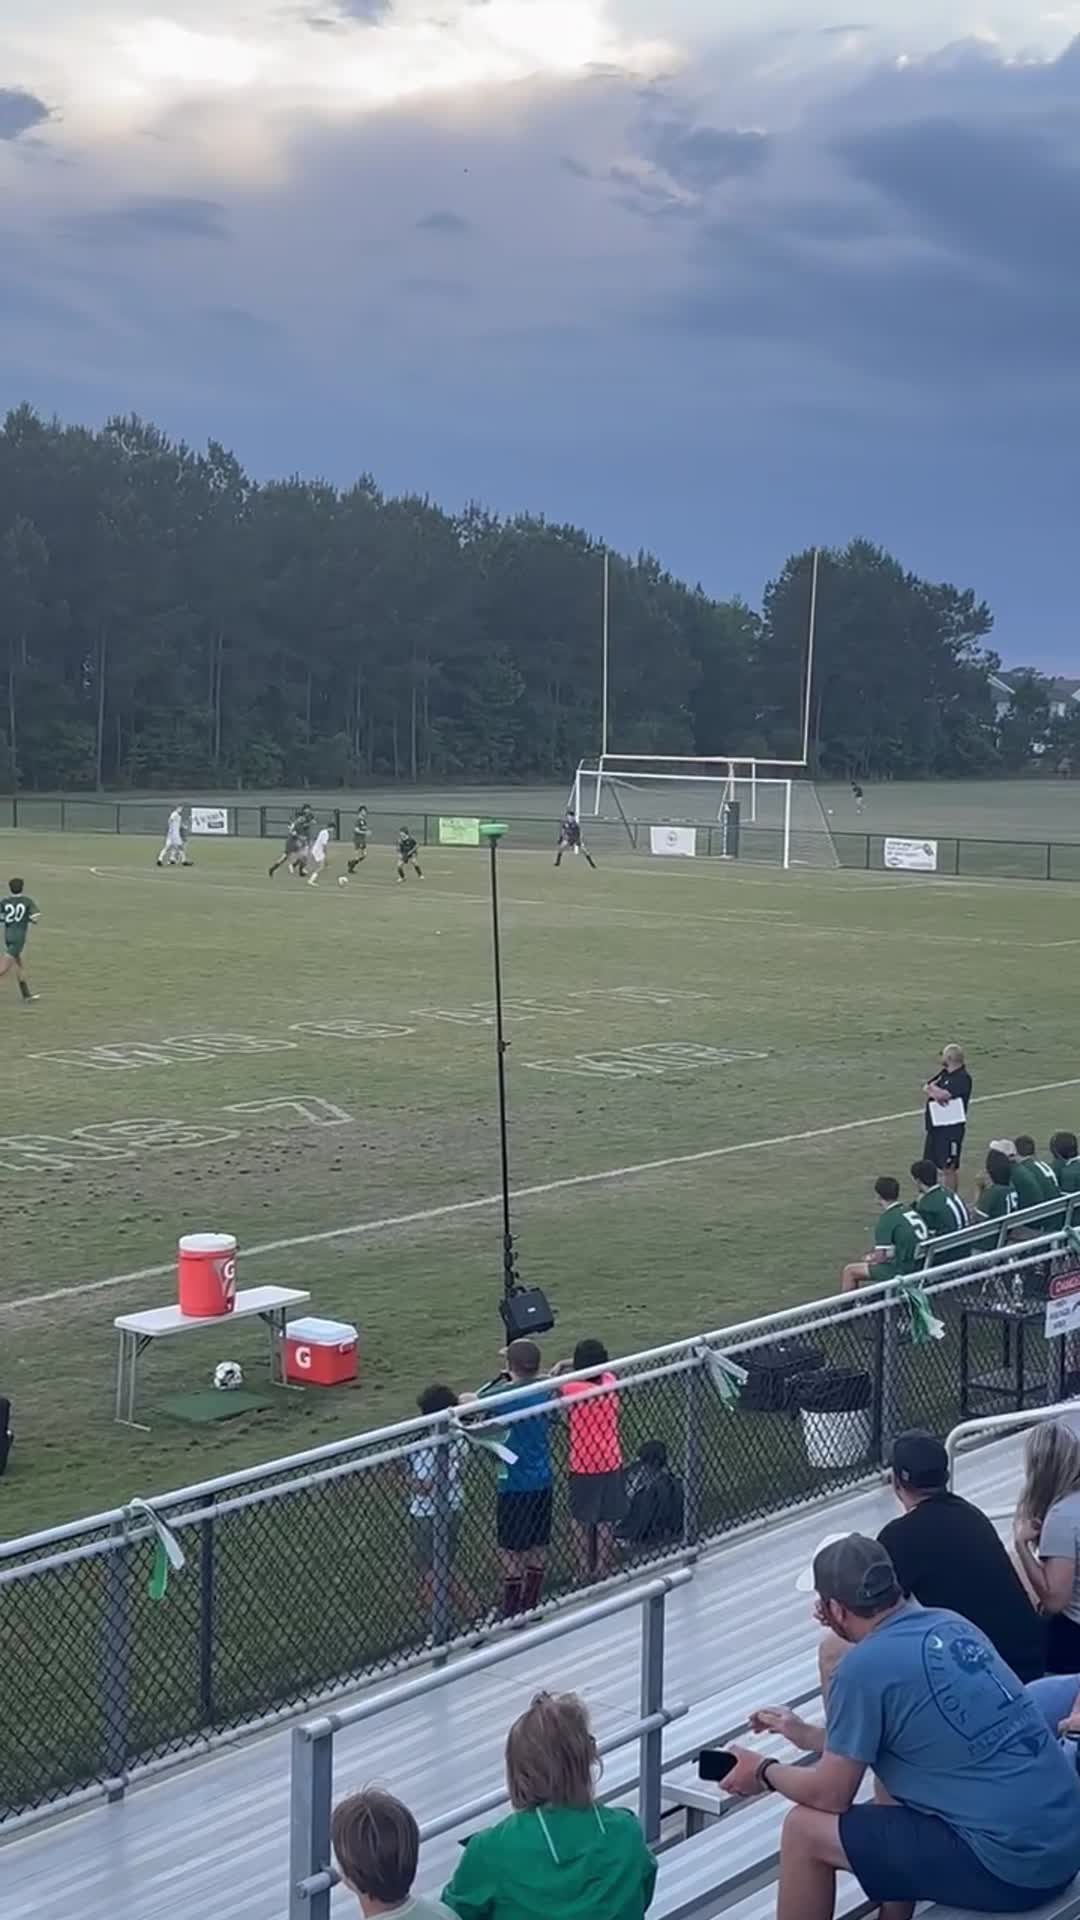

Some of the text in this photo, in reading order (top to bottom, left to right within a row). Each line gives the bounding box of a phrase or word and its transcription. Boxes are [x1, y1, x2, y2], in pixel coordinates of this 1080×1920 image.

[4, 903, 26, 923] 20
[222, 1095, 355, 1126] 7
[1034, 1160, 1059, 1187] 4
[946, 1193, 970, 1229] 11
[903, 1210, 928, 1240] 5
[223, 1260, 236, 1279] G
[295, 1346, 312, 1369] G
